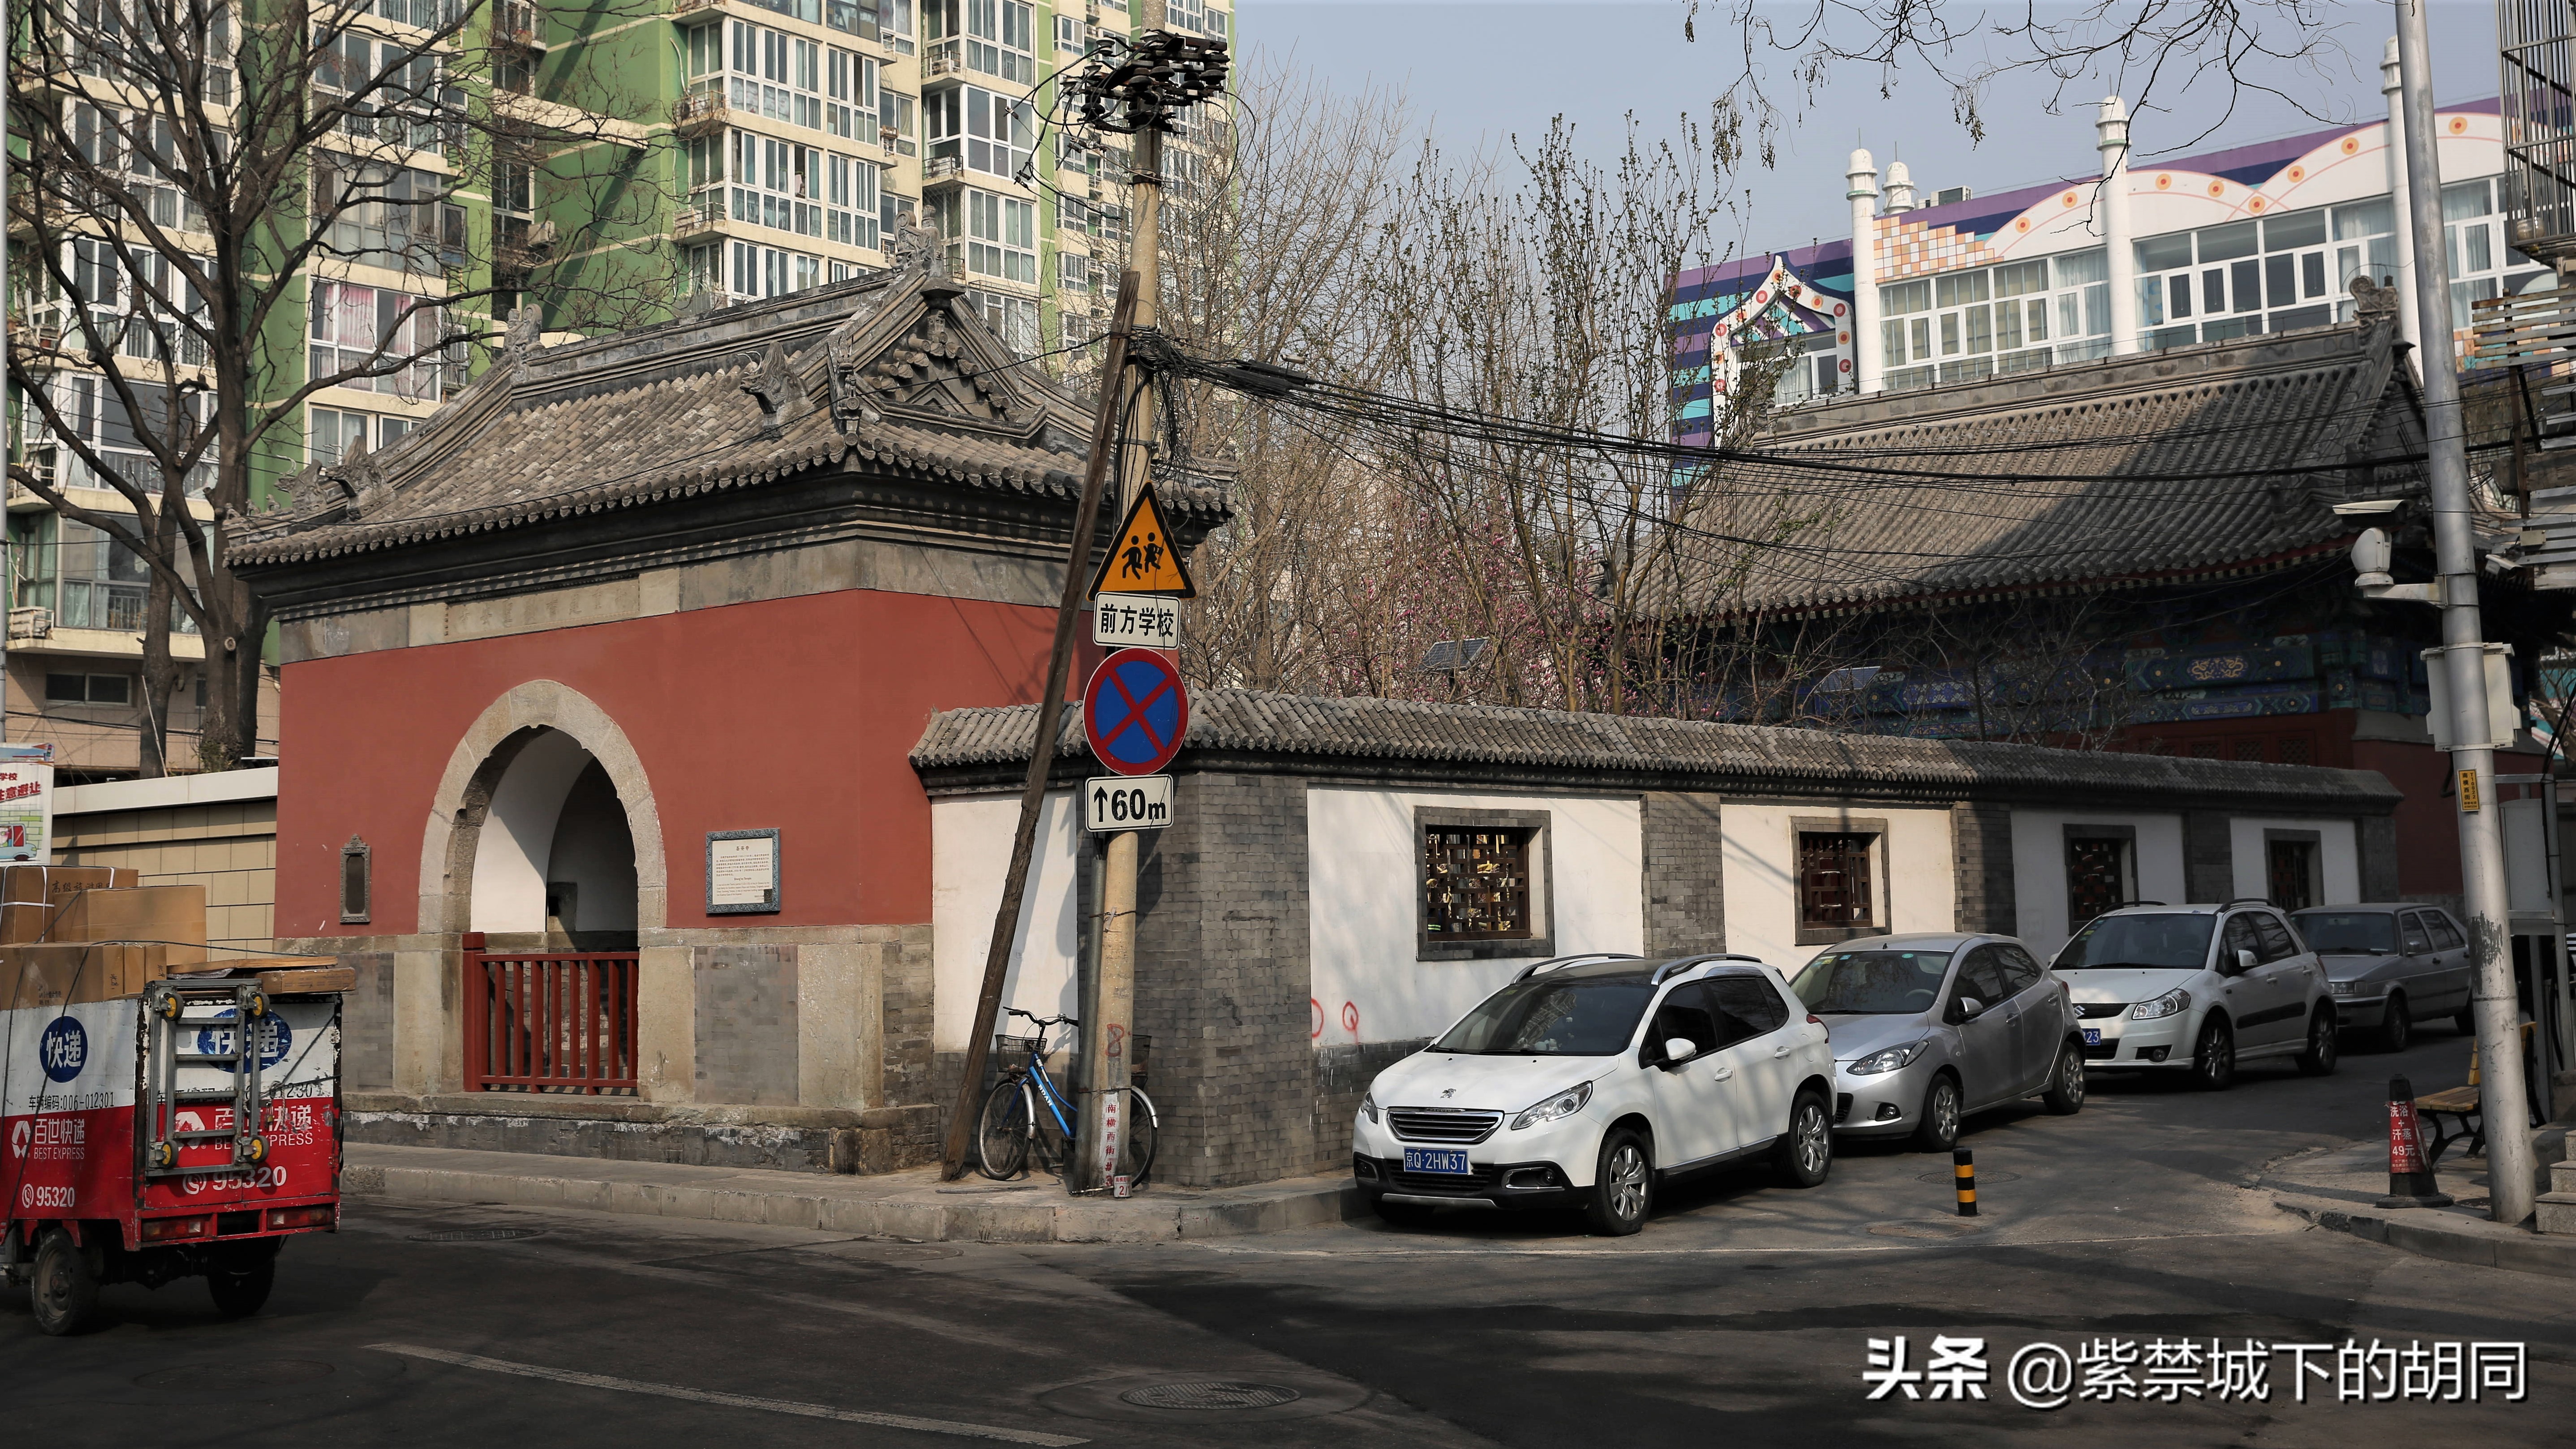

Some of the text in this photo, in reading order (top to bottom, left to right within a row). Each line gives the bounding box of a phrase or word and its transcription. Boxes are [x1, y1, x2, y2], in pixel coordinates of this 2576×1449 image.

[1100, 603, 1174, 637] 前方学校
[1112, 789, 1166, 821] 60m
[46, 1030, 81, 1069] 快递
[2390, 1105, 2408, 1117] 洗浴
[35, 1118, 85, 1144] 百世快递
[2392, 1128, 2412, 1140] 汗蒸
[34, 1147, 85, 1159] BEST EXPRESS
[2392, 1144, 2415, 1156] 49元
[212, 1165, 287, 1191] 95320
[36, 1186, 75, 1207] 95320
